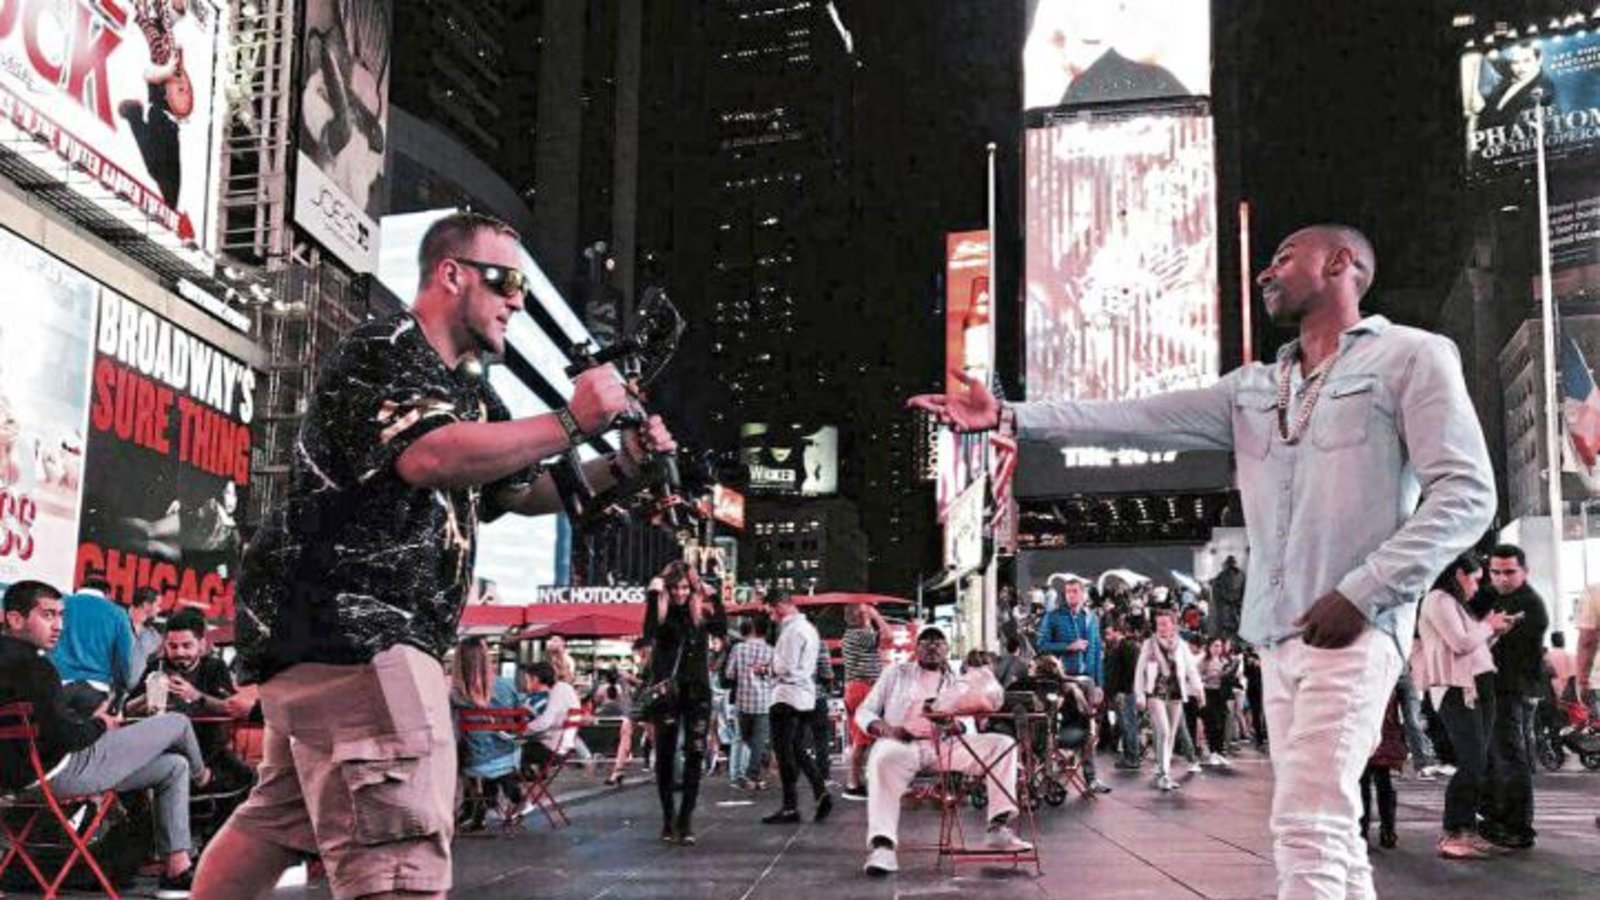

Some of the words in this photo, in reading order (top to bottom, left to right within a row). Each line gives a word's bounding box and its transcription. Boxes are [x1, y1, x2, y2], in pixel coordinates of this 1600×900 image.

[98, 285, 255, 423] BROADWAY'S
[93, 358, 174, 454] SURE
[178, 394, 251, 484] THING
[539, 587, 569, 603] NYC
